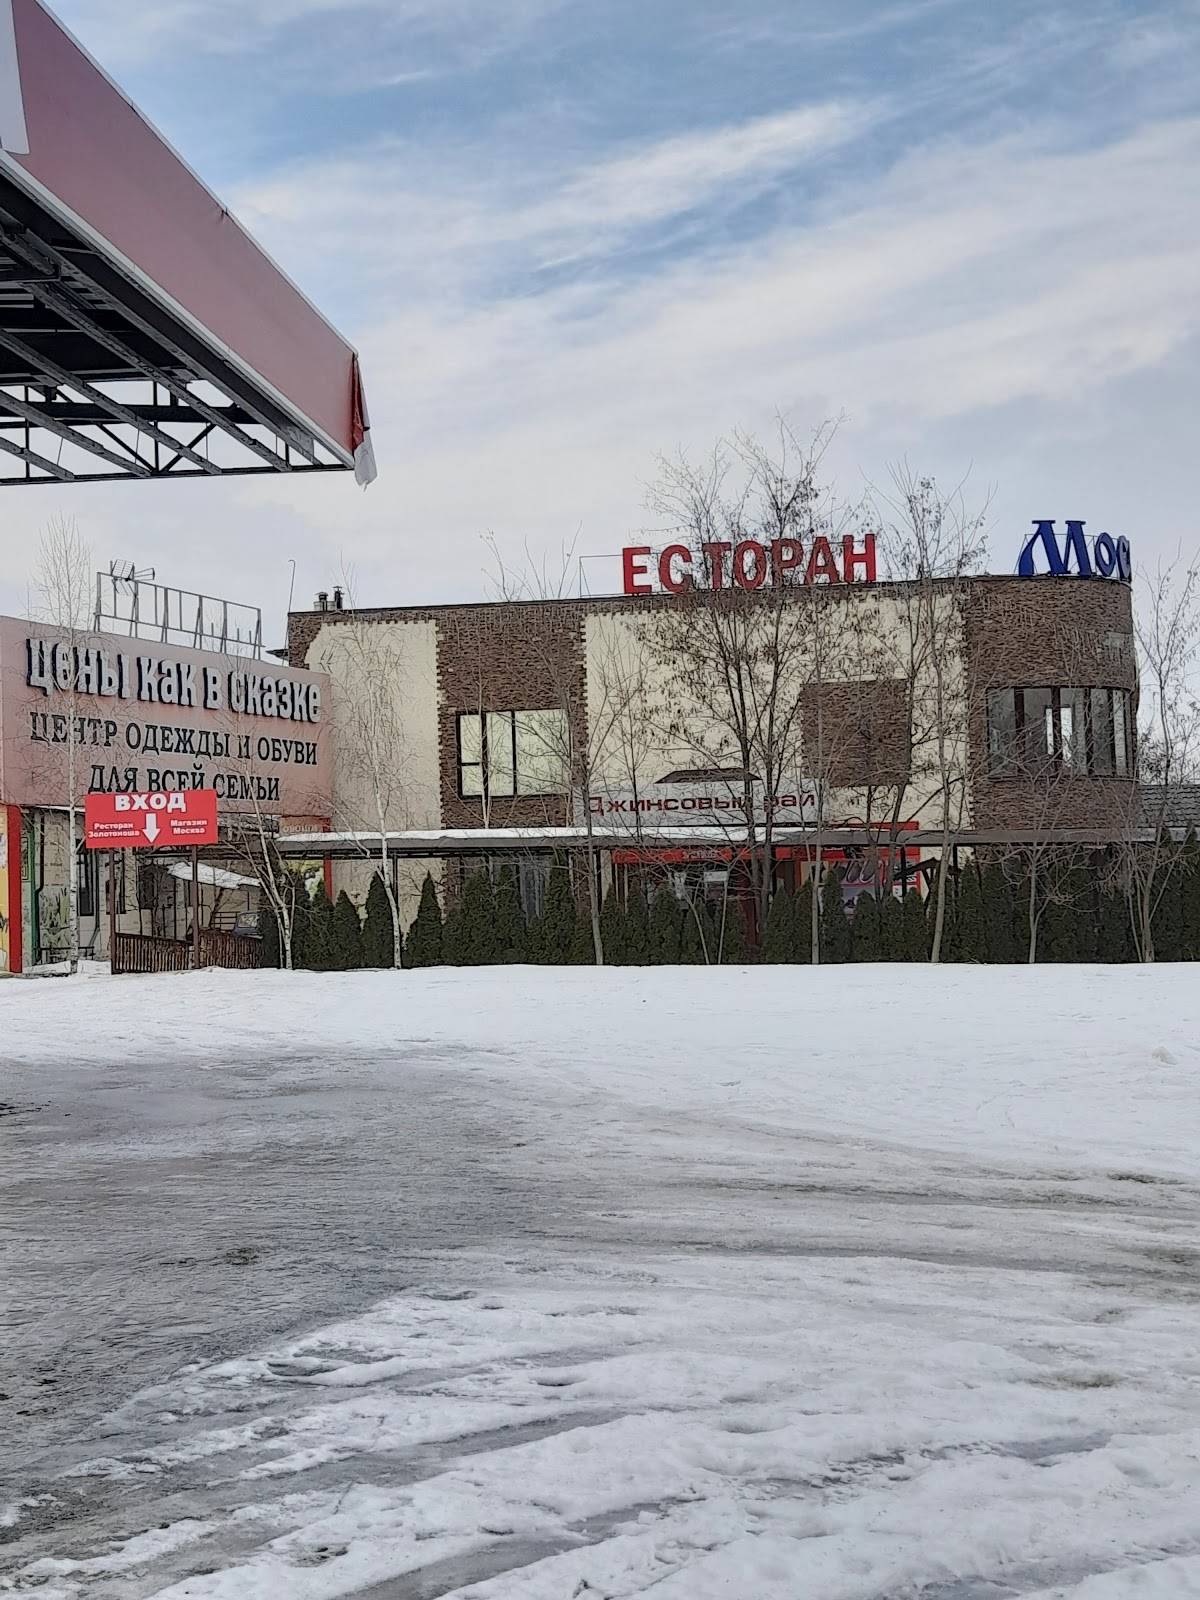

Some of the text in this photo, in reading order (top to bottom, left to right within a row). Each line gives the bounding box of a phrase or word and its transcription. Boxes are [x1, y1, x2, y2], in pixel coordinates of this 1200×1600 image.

[622, 533, 877, 594] ЕСТОРАН
[30, 711, 318, 765] ЦЕНТР ОДЕЖДЫ И ОБУВИ
[88, 763, 280, 801] ДЛЯ ВСЕЙ СЕМЬИ
[115, 792, 187, 813] ВХОД
[93, 822, 134, 831] Ресторан
[170, 819, 208, 828] Магазин
[172, 827, 206, 835] Москва
[88, 830, 140, 839] Золотоноша
